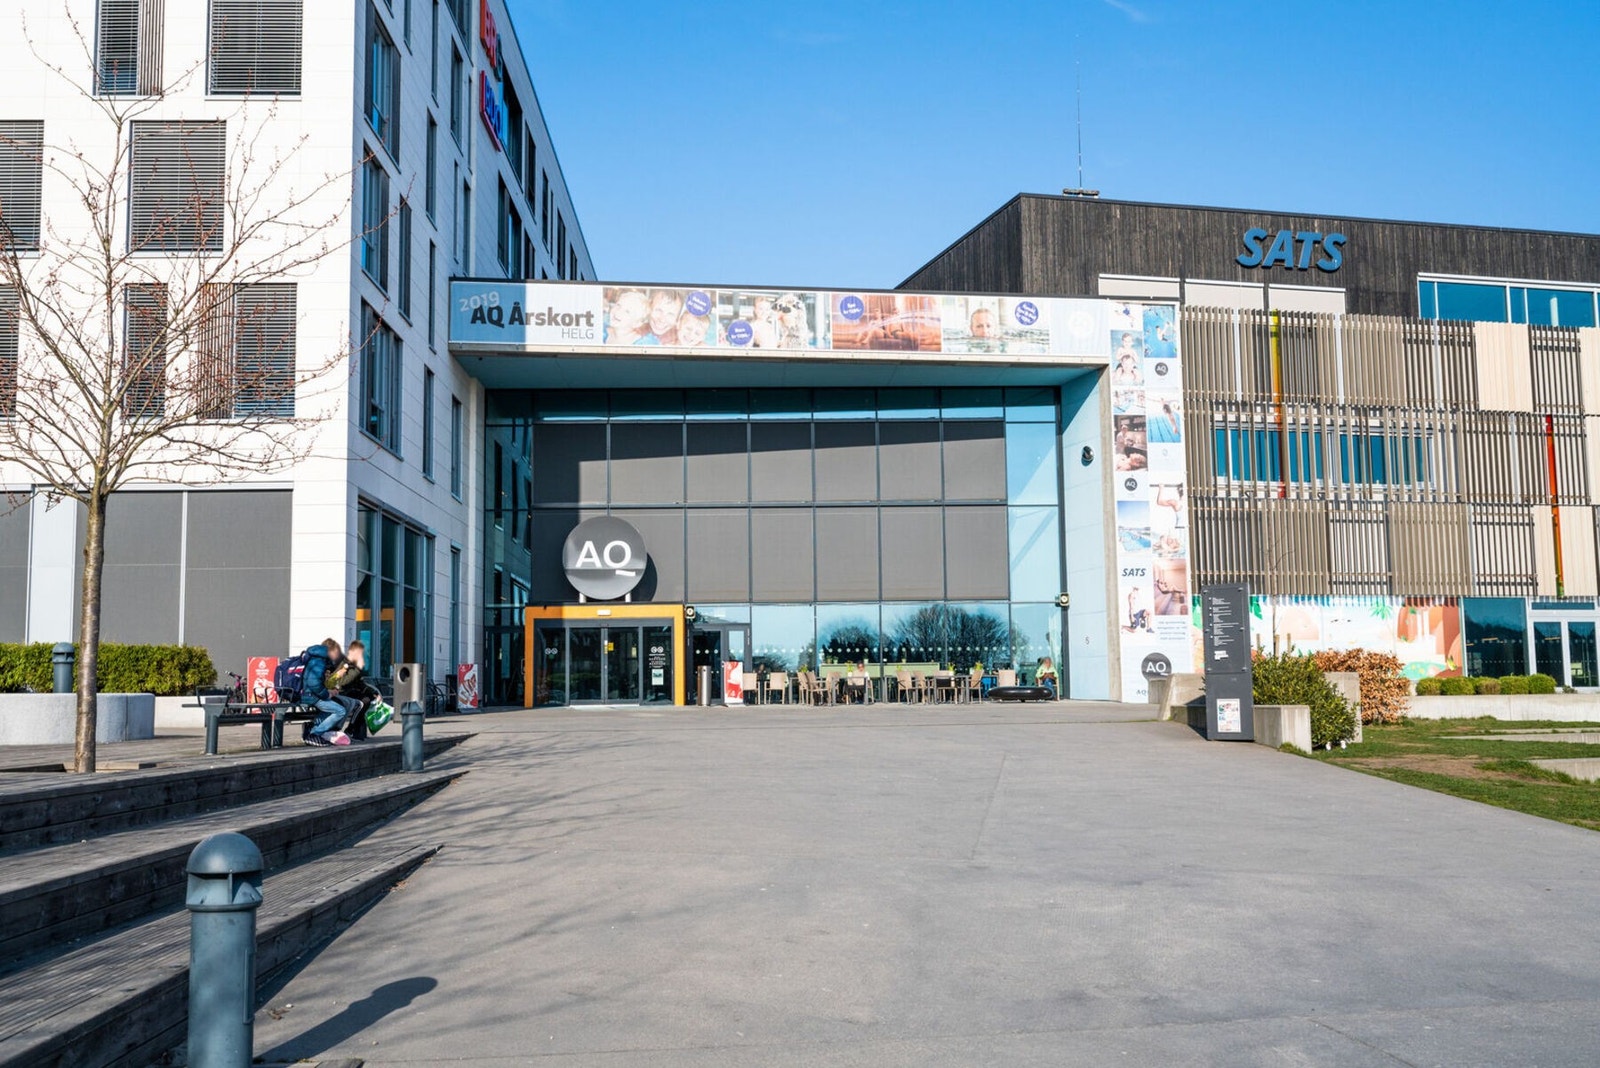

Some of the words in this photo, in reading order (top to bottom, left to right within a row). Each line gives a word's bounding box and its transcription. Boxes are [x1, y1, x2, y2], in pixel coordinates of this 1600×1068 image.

[1235, 227, 1348, 273] SATS
[459, 291, 500, 312] 2019
[470, 303, 505, 328] AQ
[508, 301, 594, 327] Årskort
[561, 327, 594, 339] HELG
[575, 540, 636, 577] AQ
[1121, 567, 1147, 577] SATS
[1145, 661, 1169, 676] AQ
